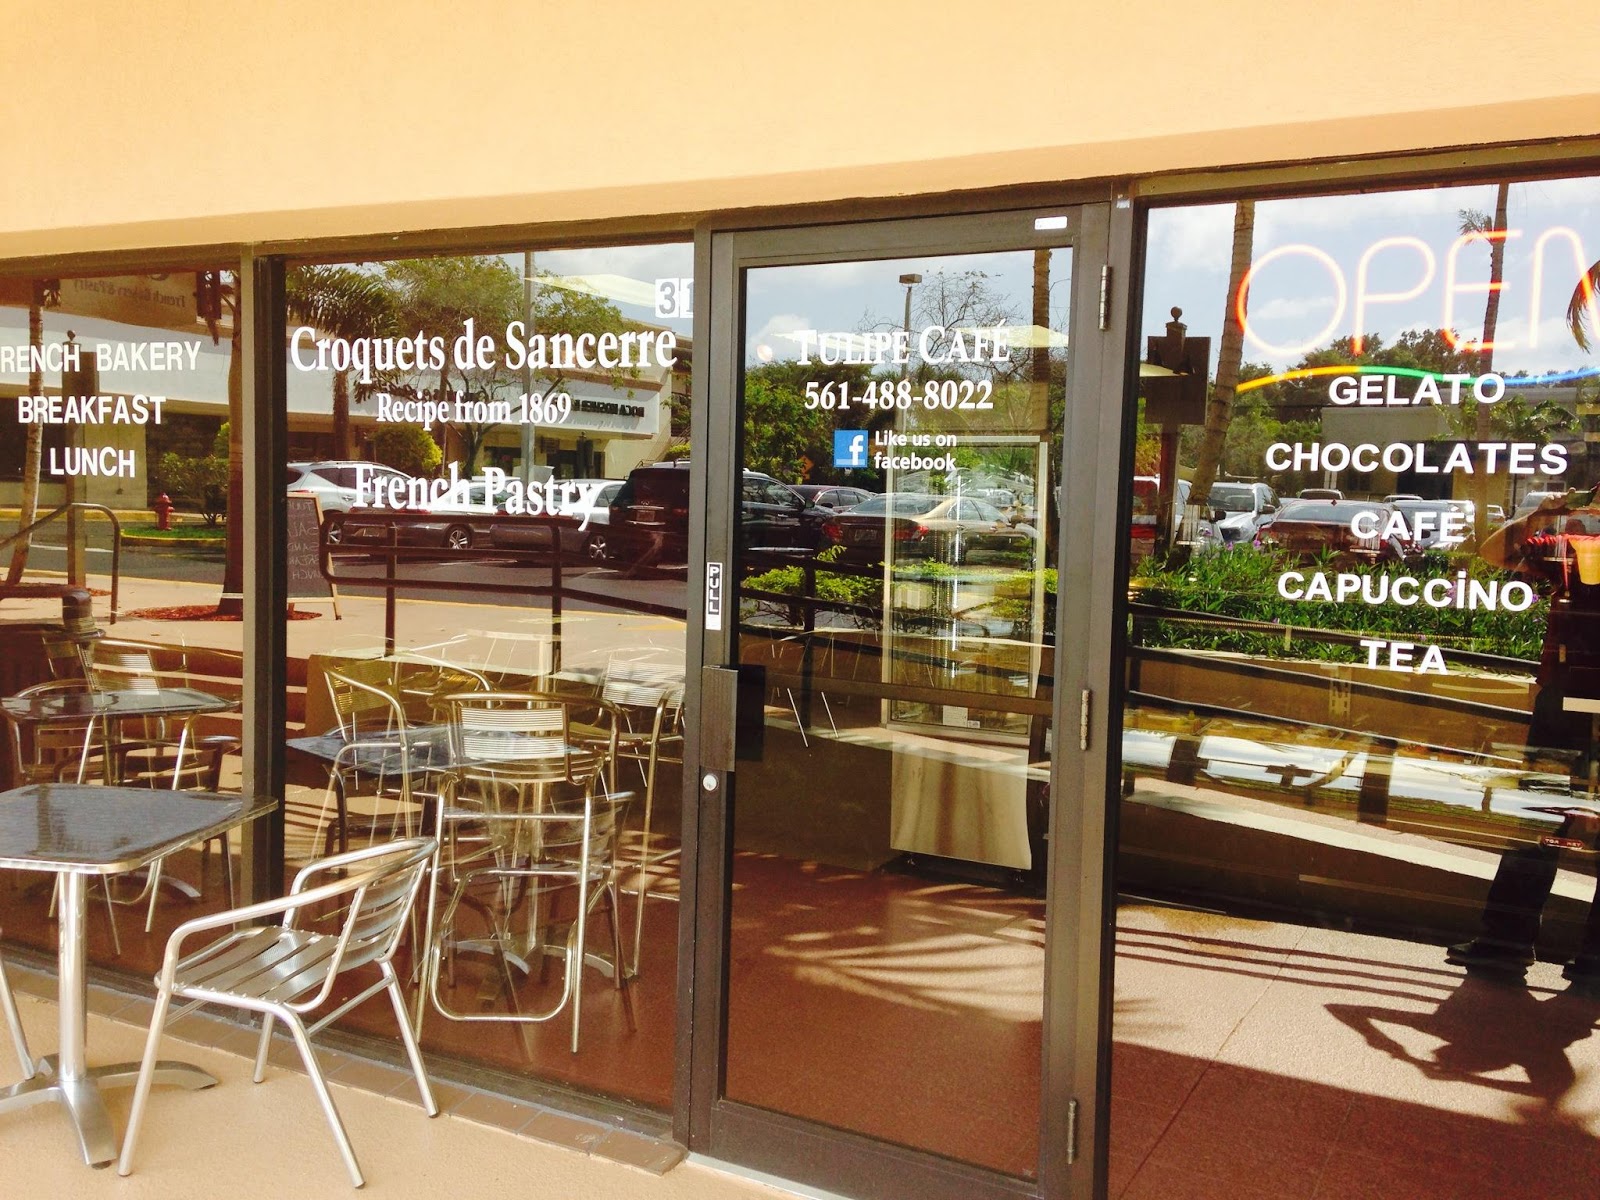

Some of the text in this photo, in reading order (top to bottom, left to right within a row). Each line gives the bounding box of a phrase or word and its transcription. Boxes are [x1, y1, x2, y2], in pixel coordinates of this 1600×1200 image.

[96, 340, 201, 371] BAKERY
[290, 318, 678, 384] Croquets de Sancerre
[796, 317, 1011, 366] TULIPE CAFÉ
[803, 379, 994, 410] 561-488-8022
[1328, 373, 1505, 406] GELATO
[17, 394, 166, 425] BREAKFAST
[376, 392, 450, 431] Recipe
[455, 393, 512, 424] from
[518, 392, 572, 425] 1869
[875, 430, 957, 447] Like us on
[50, 446, 136, 478] LUNCH
[874, 452, 957, 472] facebook
[1264, 442, 1568, 475] CHOCOLATES
[351, 461, 601, 532] French Pastry
[709, 566, 720, 613] PULL
[1360, 640, 1447, 675] TEA
